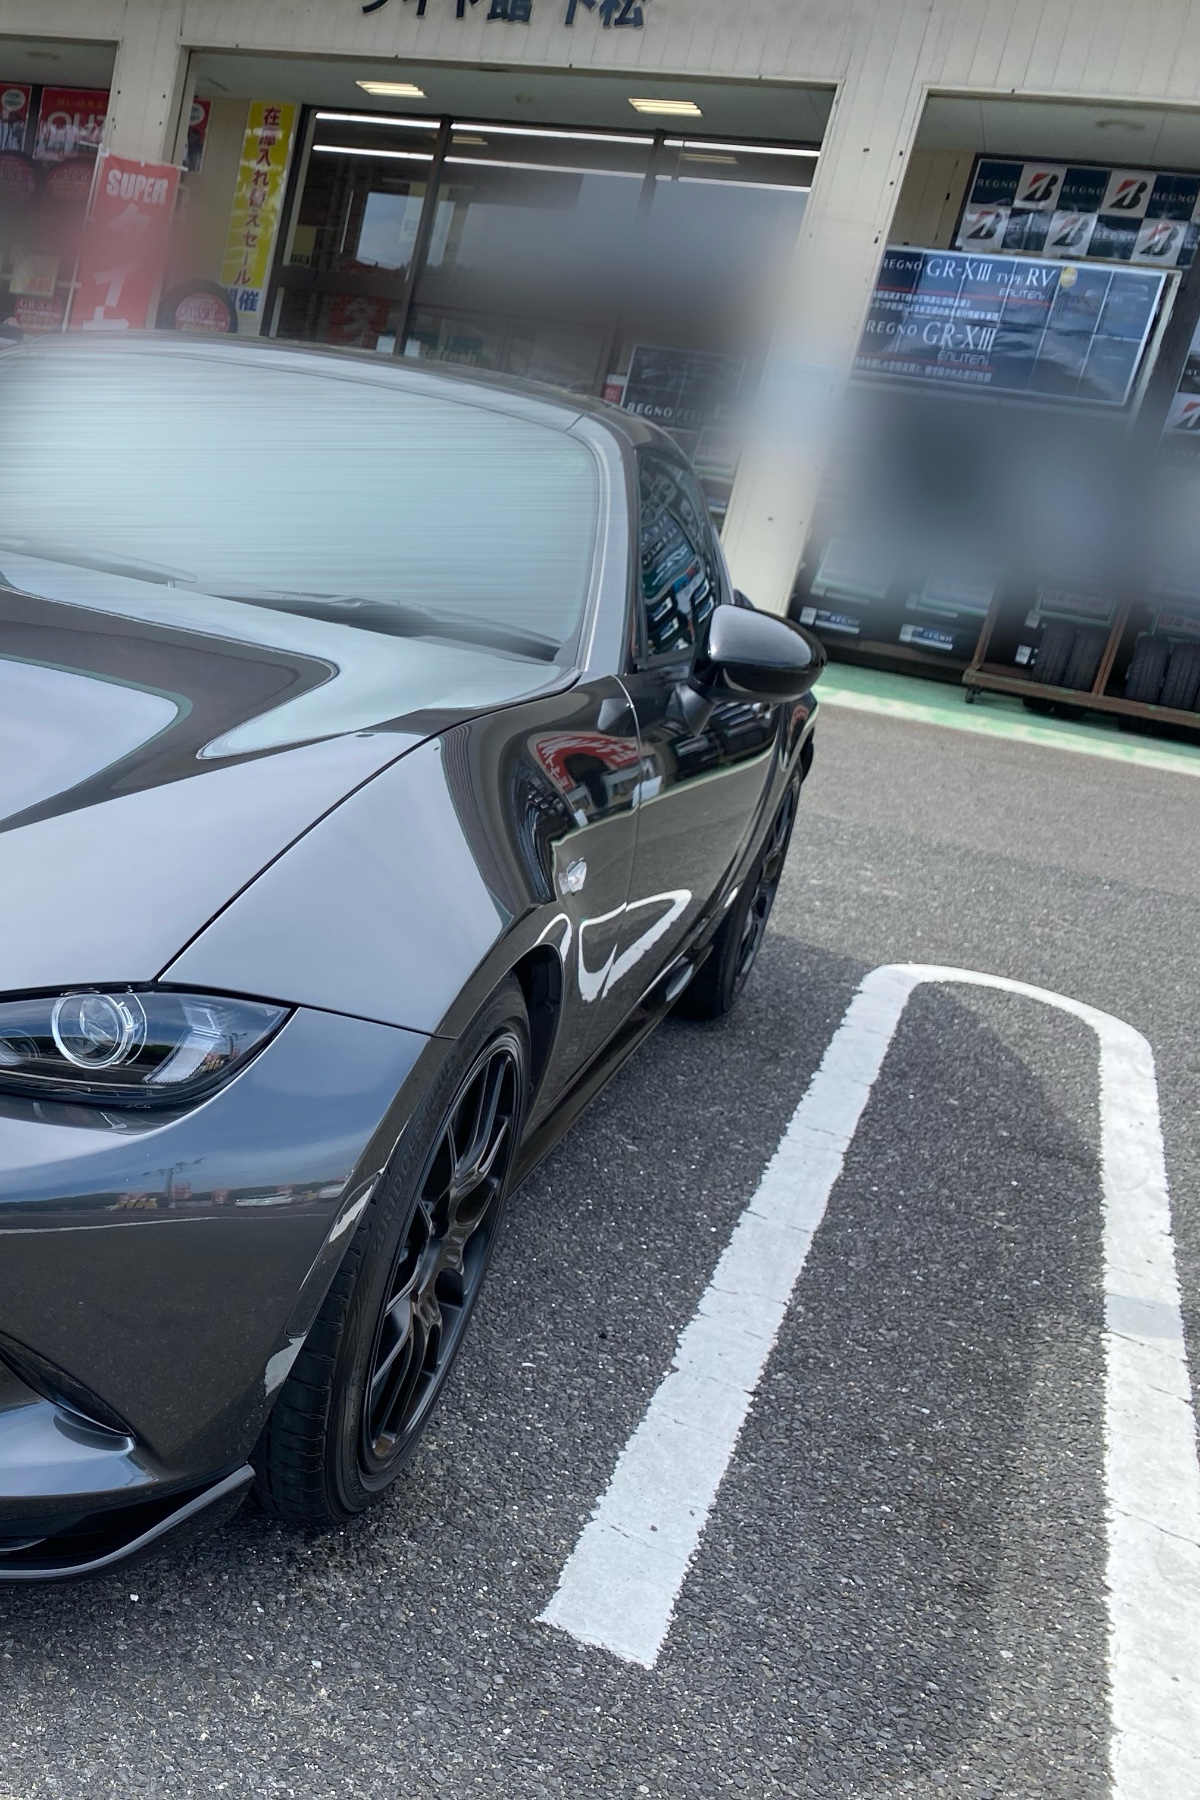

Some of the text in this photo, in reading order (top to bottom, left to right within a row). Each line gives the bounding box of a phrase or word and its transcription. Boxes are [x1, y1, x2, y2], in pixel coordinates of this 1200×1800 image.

[106, 168, 169, 205] SUPER
[976, 178, 1018, 190] REGNO
[1062, 184, 1104, 196] REGNO
[1152, 191, 1196, 203] REGNO
[882, 258, 922, 271] REGNO
[1026, 267, 1057, 287] RV
[866, 321, 917, 338] REGNO
[627, 401, 673, 418] REGNO
